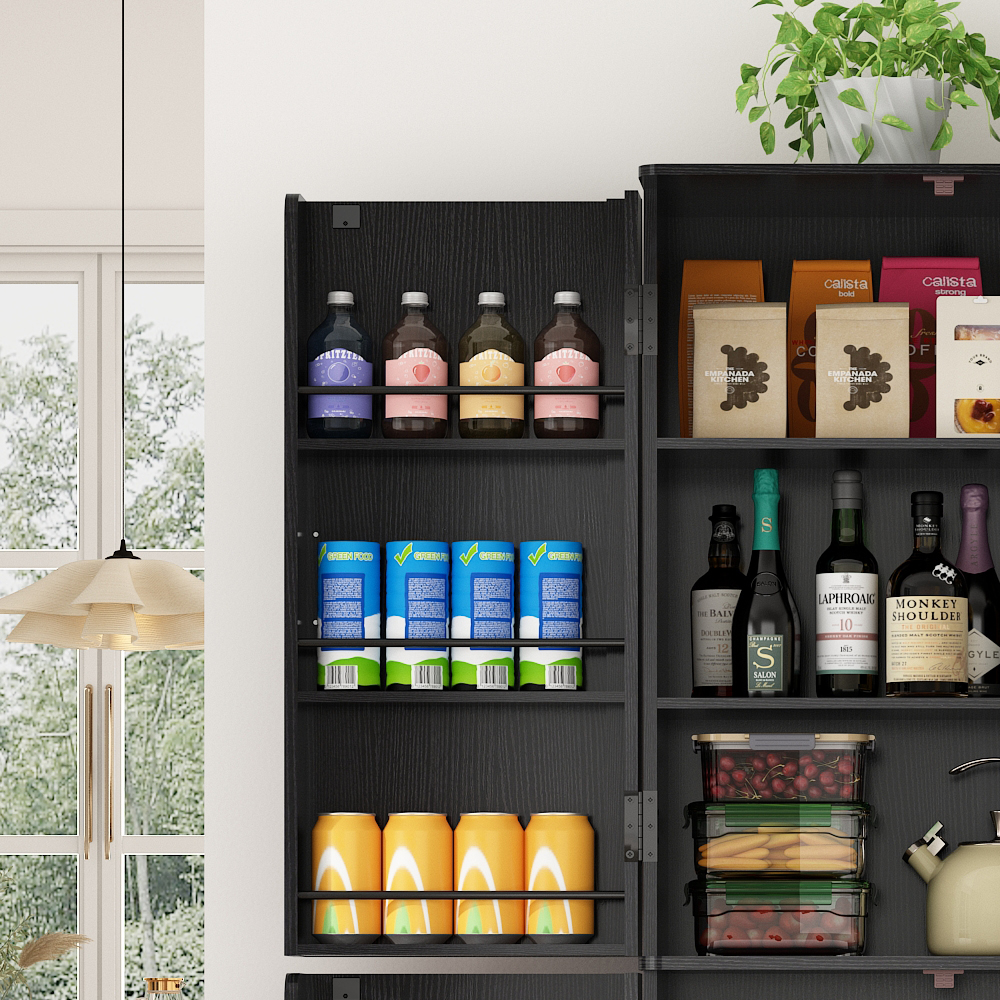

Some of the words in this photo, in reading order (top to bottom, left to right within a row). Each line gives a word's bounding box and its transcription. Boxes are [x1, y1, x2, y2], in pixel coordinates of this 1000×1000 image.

[824, 279, 868, 290] Calista
[922, 276, 976, 287] Calista
[761, 518, 773, 532] S
[327, 552, 352, 560] GREEN
[414, 552, 440, 561] GREEN
[818, 593, 875, 604] LAPHROAIG
[896, 599, 957, 609] MONKEY
[710, 609, 733, 617] BALV
[892, 612, 961, 621] SHOULDER
[840, 618, 852, 631] 10
[717, 644, 729, 653] 12
[753, 645, 774, 669] S
[968, 650, 1000, 659] GYLE
